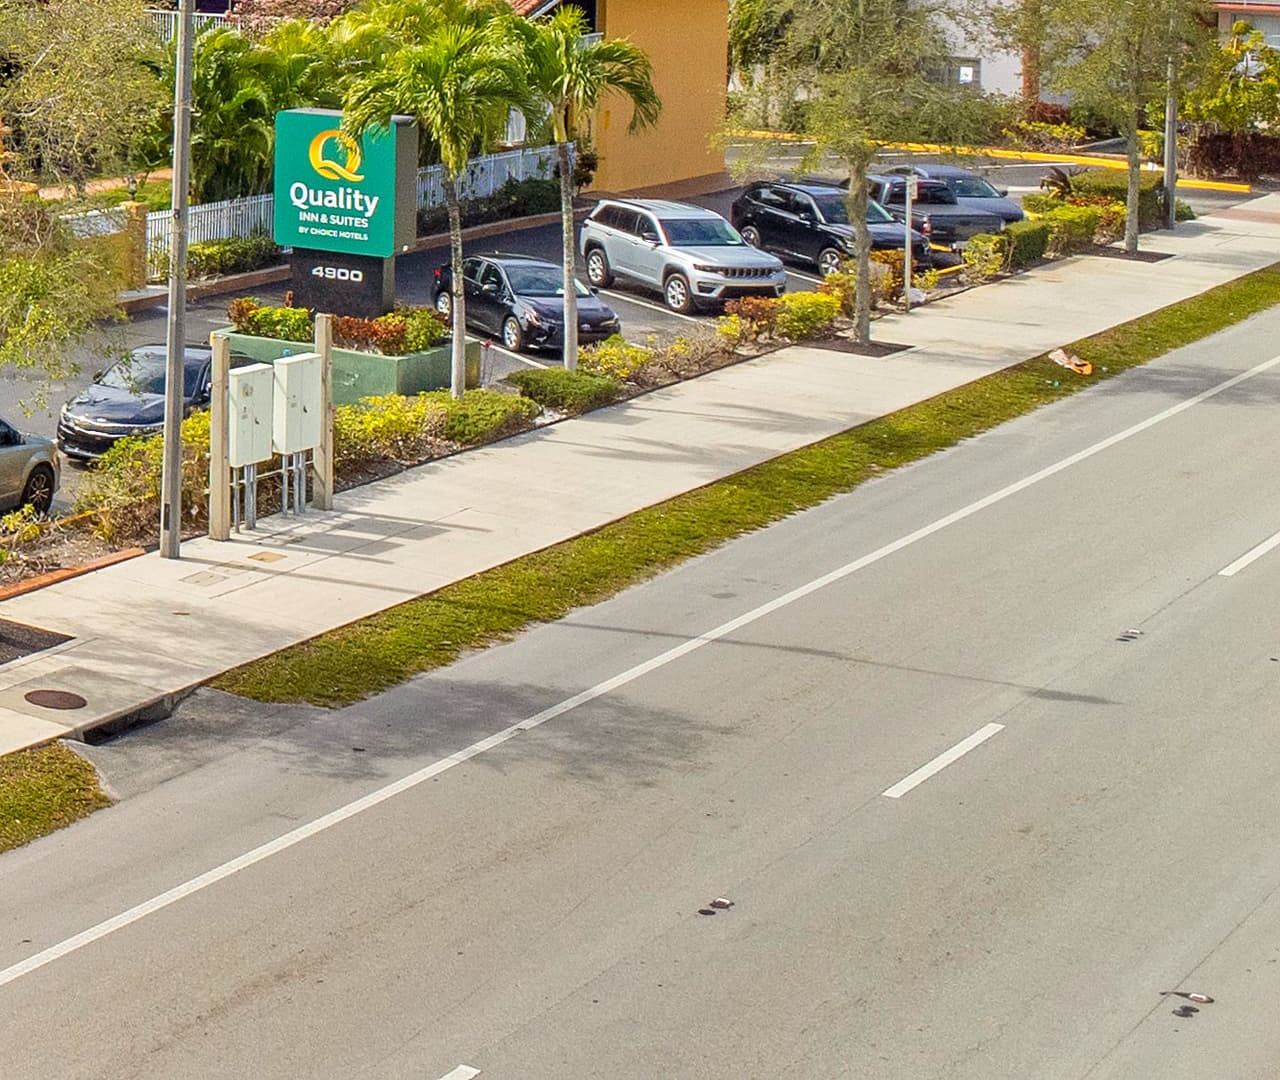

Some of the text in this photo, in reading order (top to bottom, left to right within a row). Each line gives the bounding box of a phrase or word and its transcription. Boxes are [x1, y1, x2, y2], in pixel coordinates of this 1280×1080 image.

[289, 182, 379, 217] Quality
[299, 211, 369, 229] INN & SUITES
[298, 226, 369, 241] BY CHOICE HOTELS
[311, 266, 364, 282] 4900
